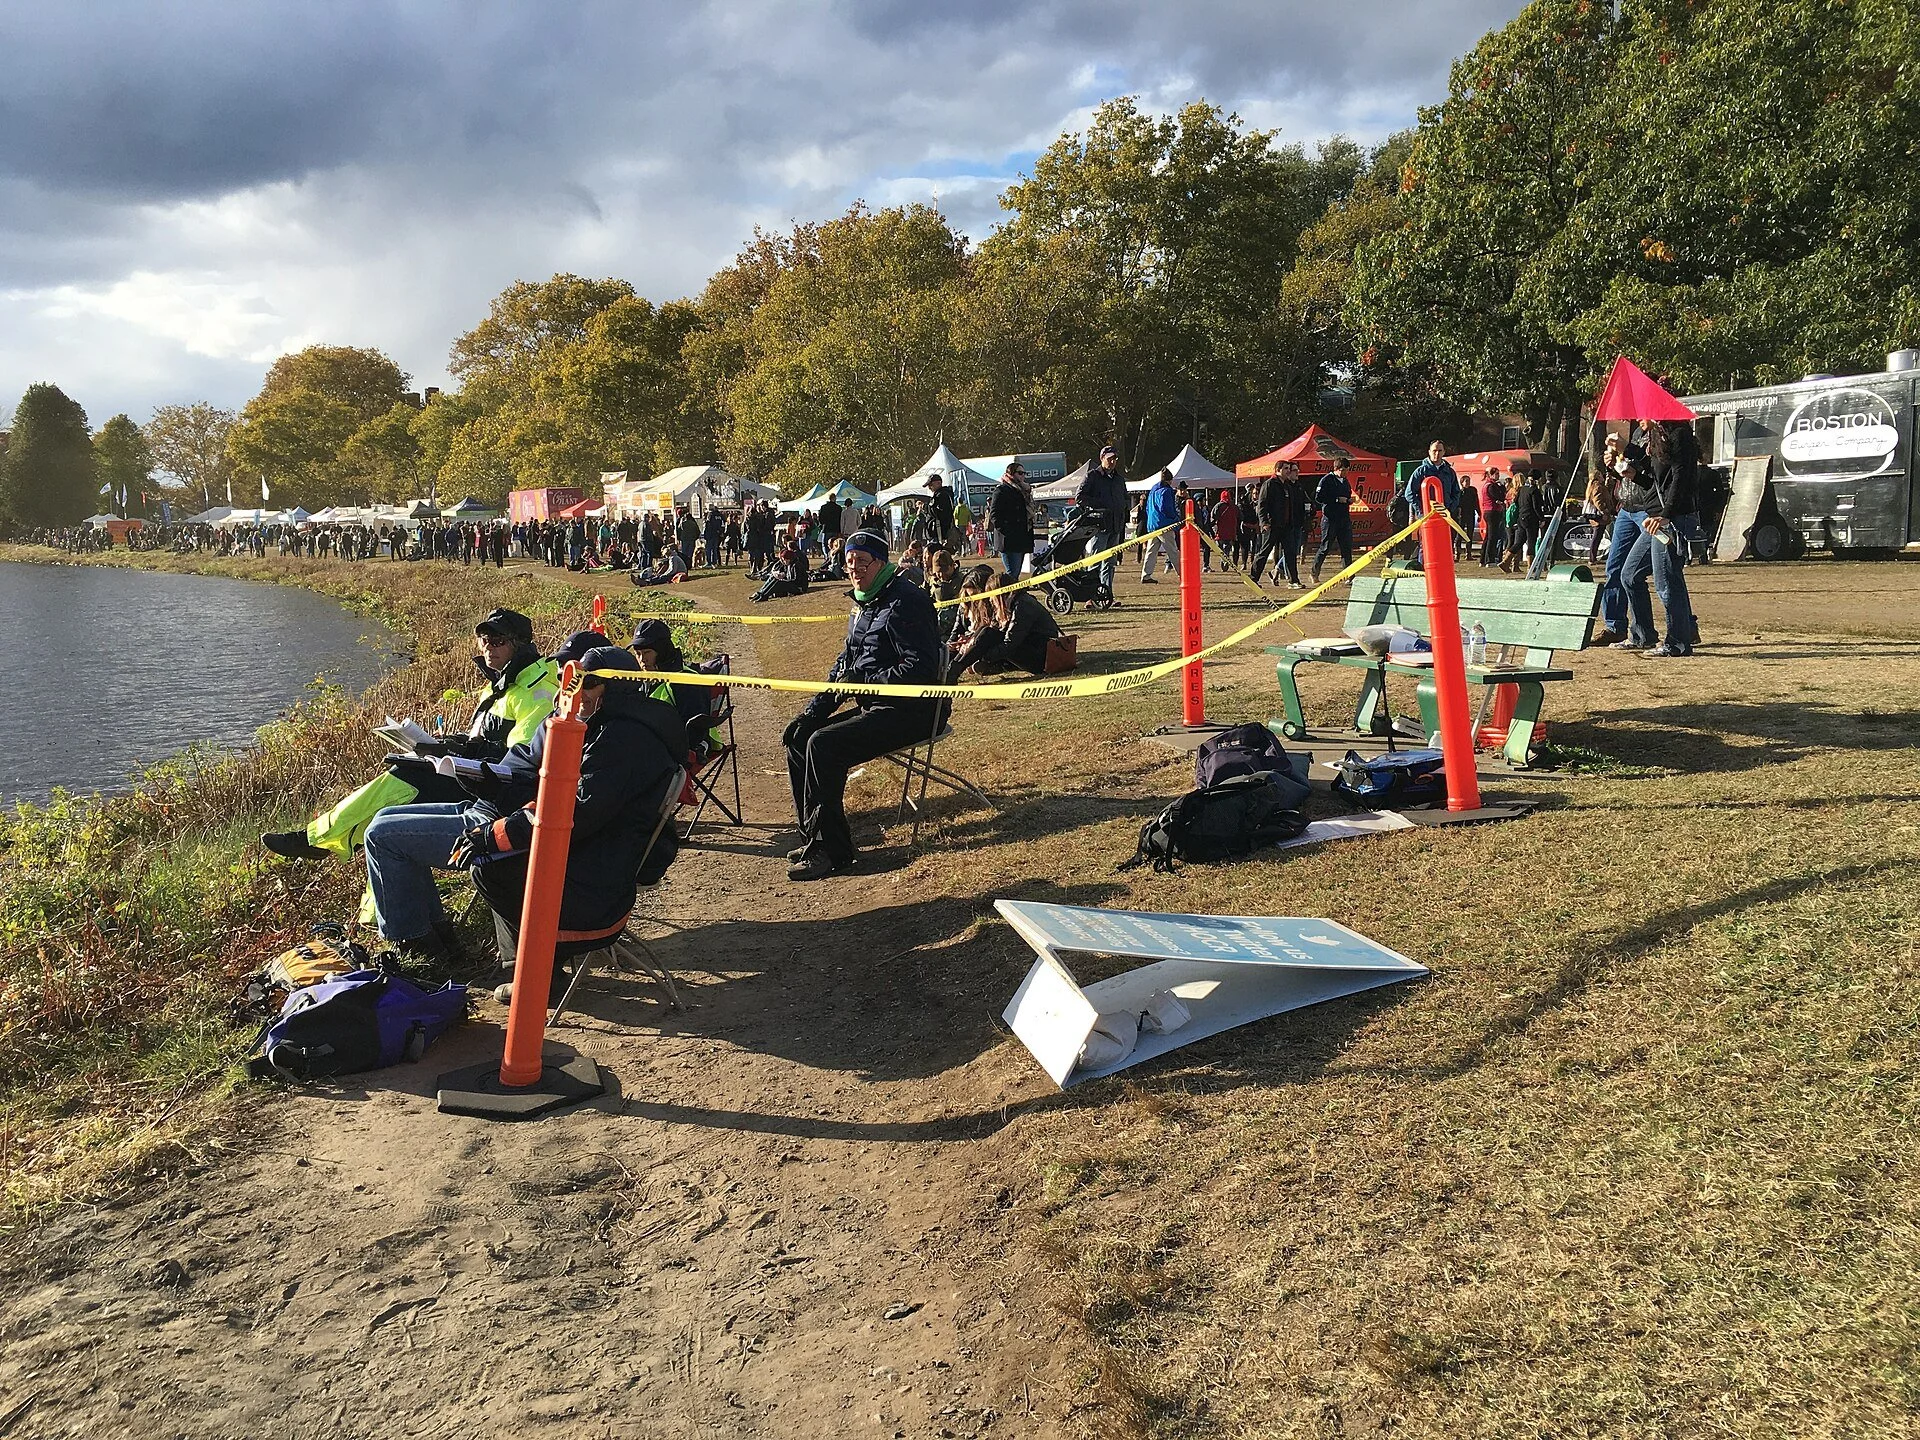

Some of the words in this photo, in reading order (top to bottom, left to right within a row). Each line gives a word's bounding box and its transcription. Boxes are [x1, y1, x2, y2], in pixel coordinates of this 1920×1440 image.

[1796, 411, 1883, 432] BOSTON
[1789, 439, 1830, 457] Burger
[1835, 435, 1888, 453] Company
[1024, 468, 1059, 479] GEICO
[968, 486, 997, 494] GEICO
[1355, 476, 1391, 505] 5-hour
[1188, 612, 1200, 706] UMPRES
[1020, 684, 1073, 699] CAUTION
[1105, 670, 1153, 691] CUIDADO
[1198, 917, 1226, 928] on
[1217, 929, 1284, 960] Twitter
[1231, 919, 1299, 947] Follow
[1281, 947, 1315, 960] us
